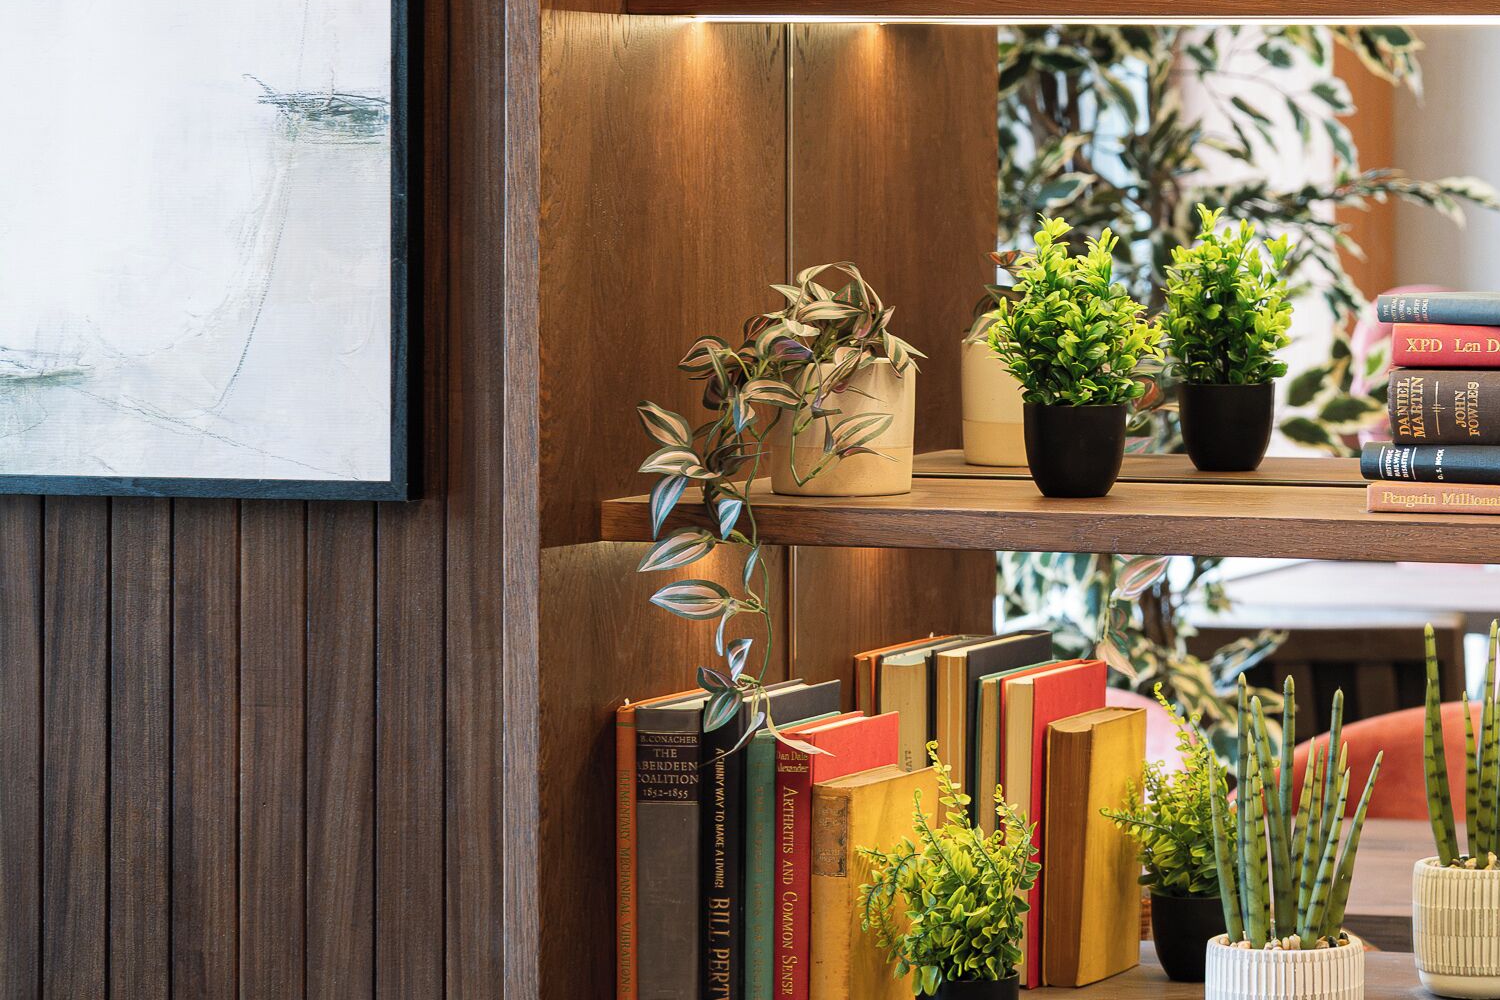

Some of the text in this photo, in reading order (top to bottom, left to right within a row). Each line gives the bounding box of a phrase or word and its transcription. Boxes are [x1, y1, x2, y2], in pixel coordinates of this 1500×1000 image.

[1406, 338, 1443, 352] XPD
[1454, 338, 1481, 352] Len
[1397, 377, 1412, 436] DANIEL
[1411, 376, 1426, 438] MARTIN
[1454, 390, 1467, 428] JOHN
[1467, 381, 1480, 437] FOWLES
[1385, 449, 1394, 477] HISTORIC
[1393, 448, 1402, 477] RAILWAY
[1401, 447, 1410, 478] DISASTERS
[1382, 491, 1436, 507] Penguin
[653, 748, 678, 758] THE
[791, 750, 809, 760] Dale
[714, 787, 726, 808] WAY
[714, 811, 725, 822] TO
[714, 824, 725, 848] MAKE
[619, 770, 631, 993] ELEMENTARY MECHANICAL VIBRATIONS
[714, 858, 725, 888] LIVING!
[781, 785, 799, 995] ARTHRITIS AND COMMON SENSE
[708, 897, 731, 941] BILL
